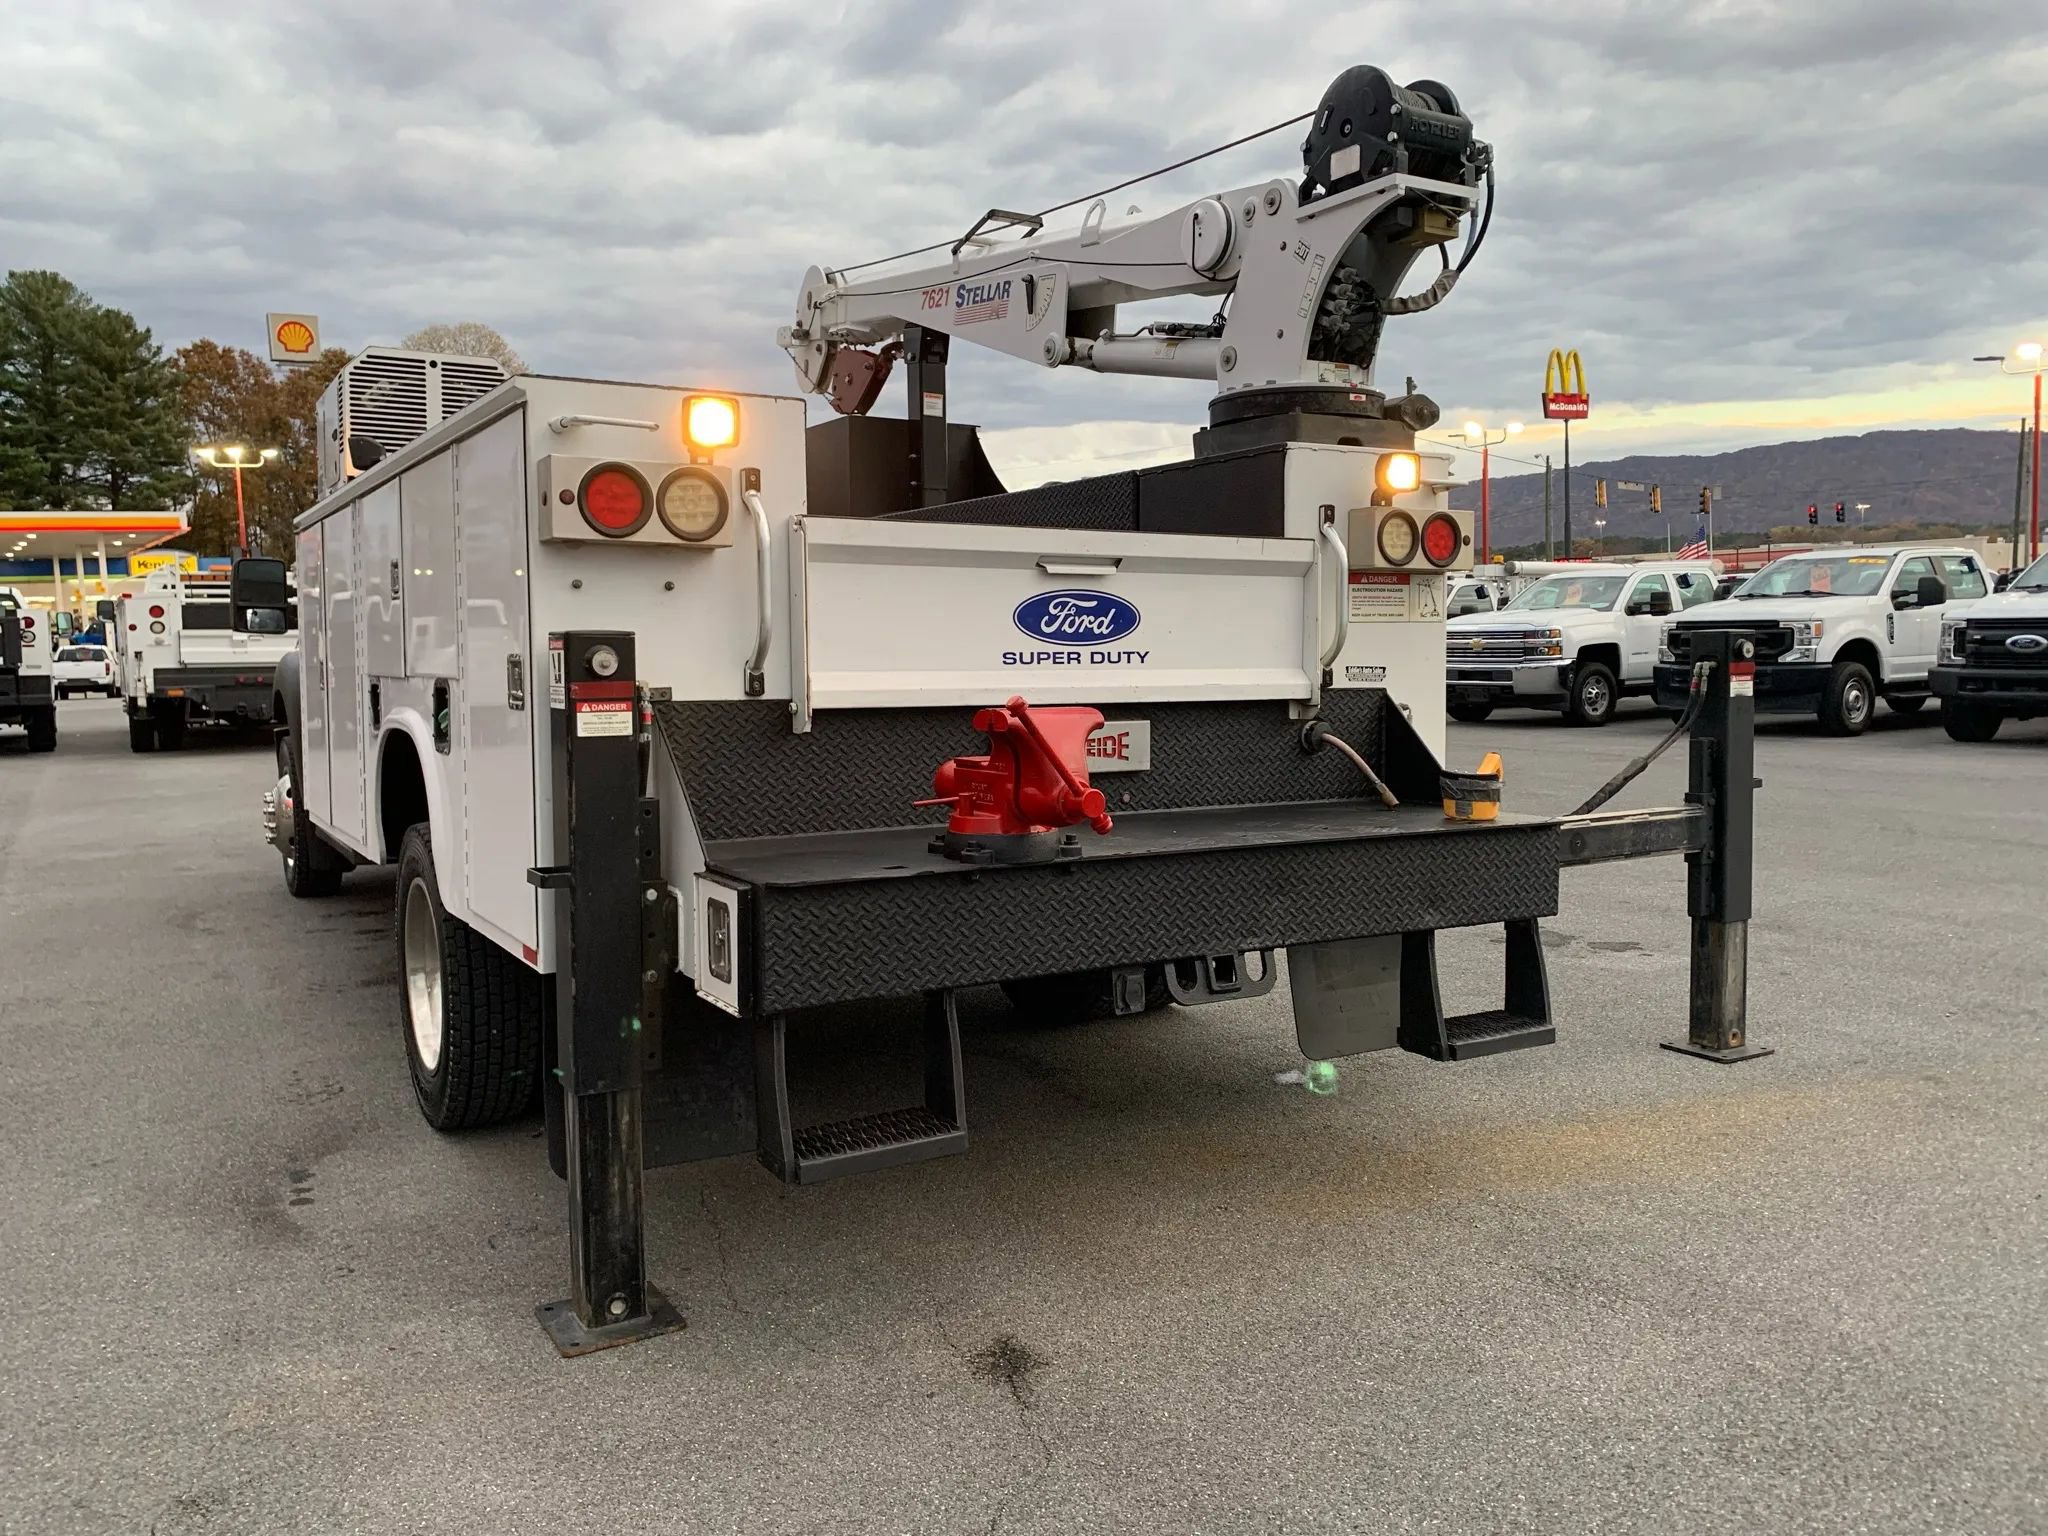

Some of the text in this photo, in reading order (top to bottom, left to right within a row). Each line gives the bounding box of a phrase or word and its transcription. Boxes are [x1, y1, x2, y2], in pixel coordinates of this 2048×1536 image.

[921, 280, 1012, 310] 7621 STELLAR
[1549, 402, 1588, 411] McDonald's
[1368, 575, 1398, 583] DANGER
[1040, 597, 1116, 635] Ford
[1002, 651, 1150, 665] SUPER DUTY
[591, 703, 627, 711] DANGER
[1086, 731, 1130, 761] EIDE
